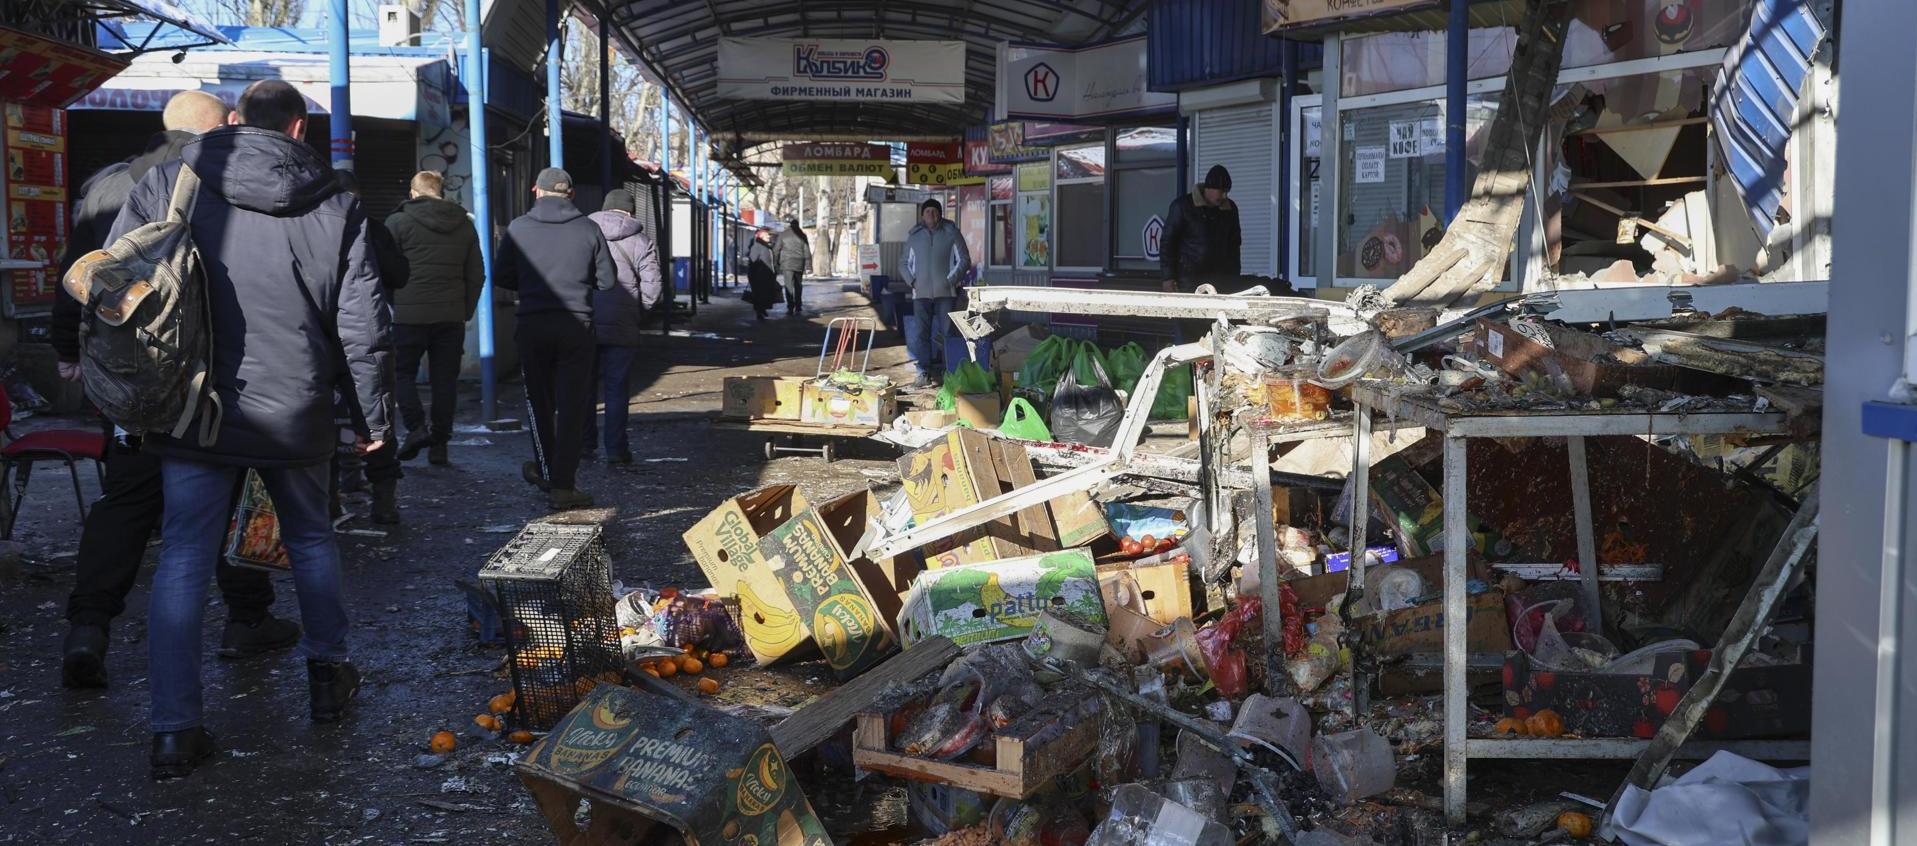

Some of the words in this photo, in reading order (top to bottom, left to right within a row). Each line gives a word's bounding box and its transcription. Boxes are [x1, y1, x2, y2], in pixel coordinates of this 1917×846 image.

[771, 85, 850, 97] ФИРМЕННЫЙ
[856, 87, 912, 98] МАГАЗИН
[1396, 124, 1414, 139] ЧАЙ
[804, 146, 871, 158] ЛОМБАРД
[910, 148, 946, 158] ЛОМБАРД
[1393, 141, 1417, 154] КОФЕ
[790, 163, 835, 173] ОБМЕН
[839, 163, 884, 173] ВАЛЮТ
[724, 510, 759, 556] Global
[715, 521, 749, 573] Village
[792, 521, 839, 586] BANANAS
[782, 532, 829, 596] PREMIUM
